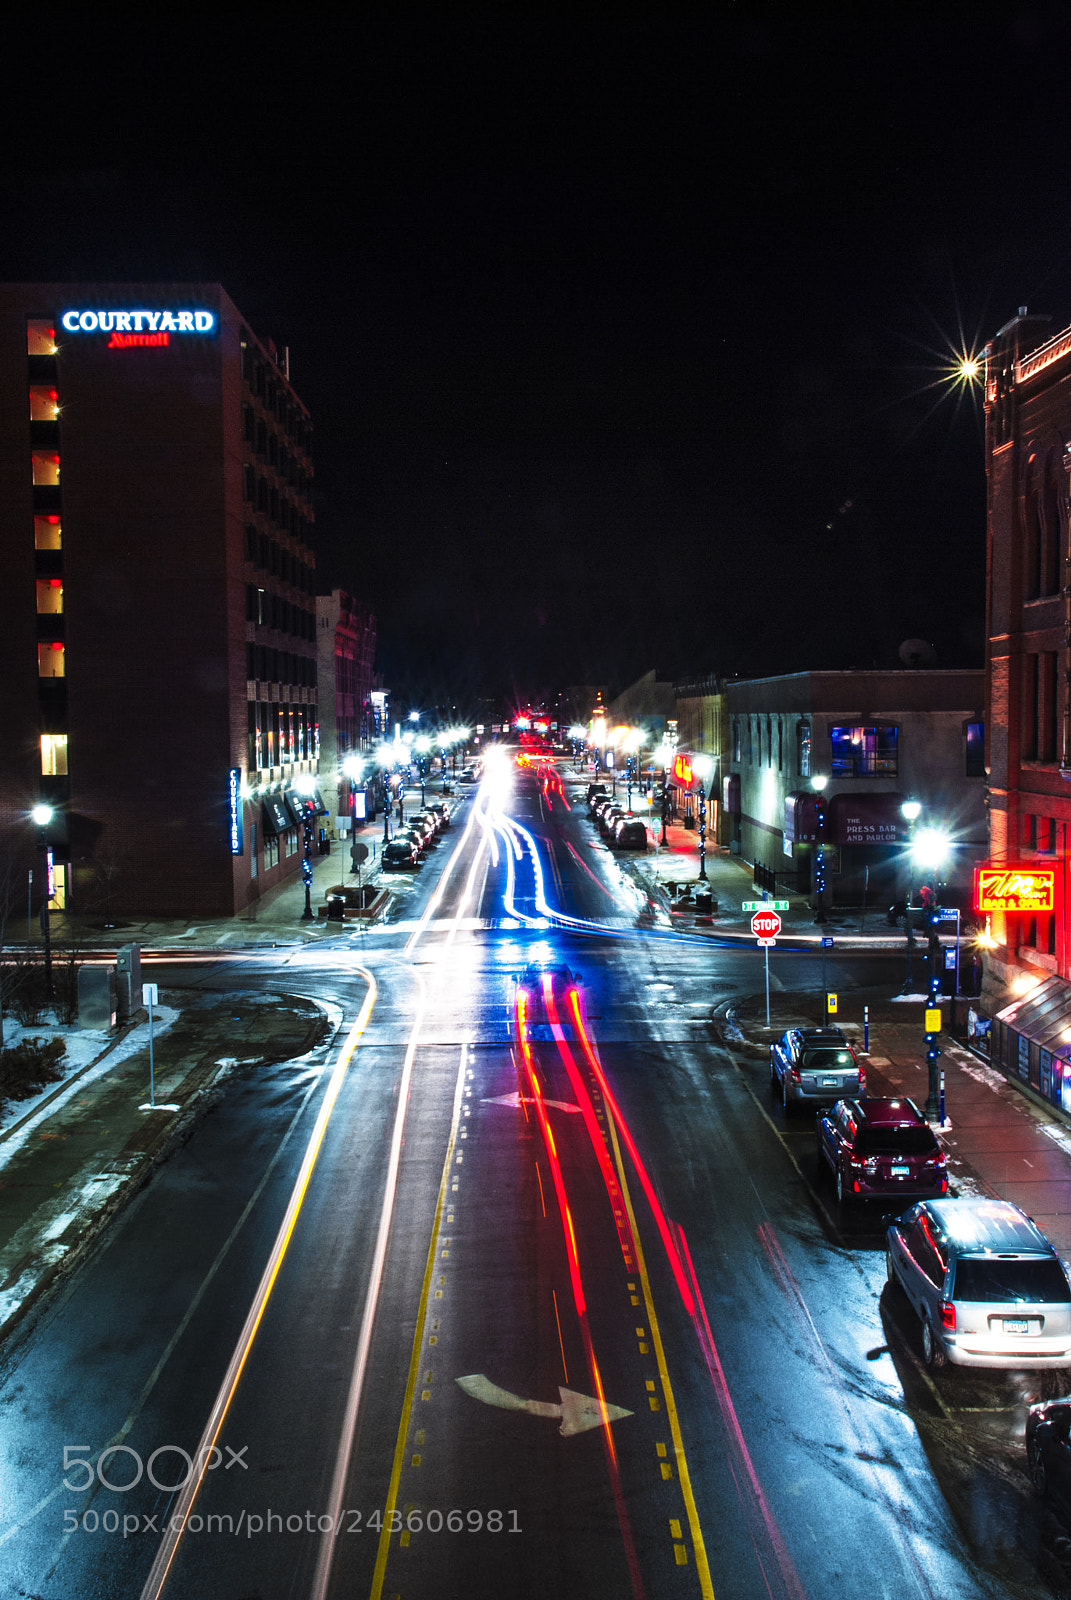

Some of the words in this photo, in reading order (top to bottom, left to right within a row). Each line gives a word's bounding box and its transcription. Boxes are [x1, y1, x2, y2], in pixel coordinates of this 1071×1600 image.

[62, 311, 214, 331] COURTYARD
[108, 332, 169, 348] Marriott
[230, 769, 239, 849] COURTYARD
[846, 825, 875, 833] PRESS
[984, 898, 1006, 908] BAR
[1008, 898, 1016, 908] &
[753, 919, 779, 931] STOP
